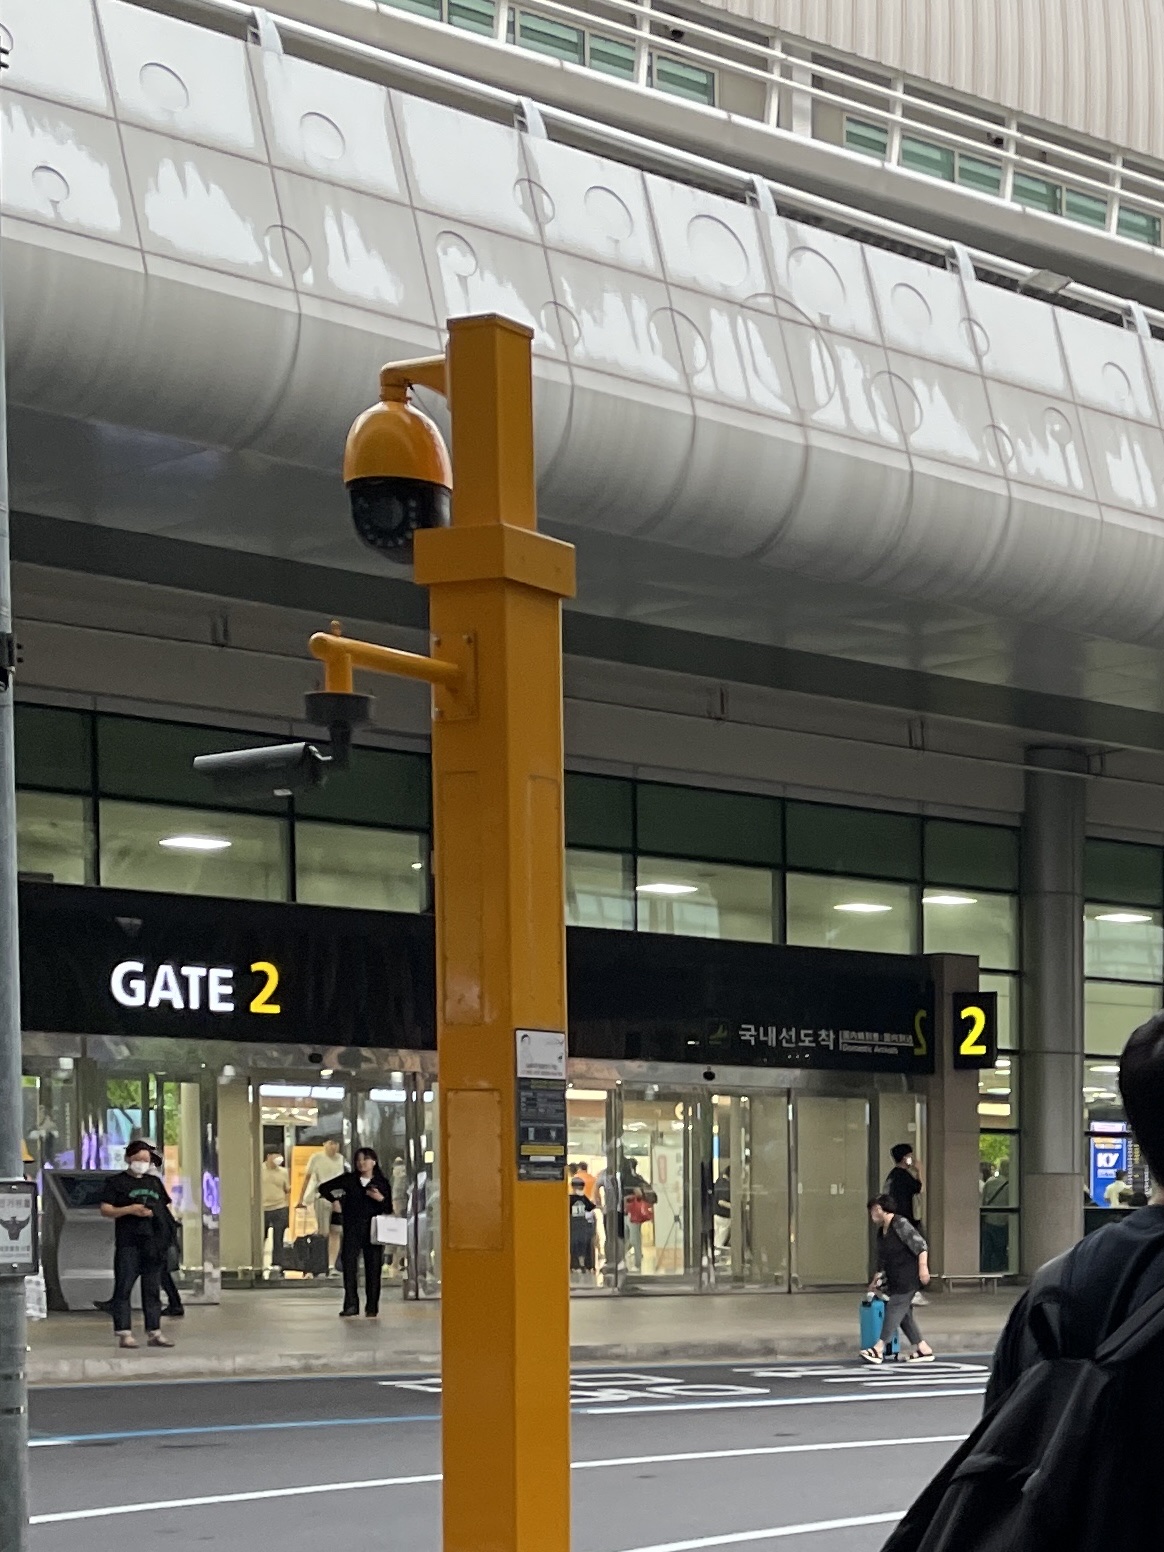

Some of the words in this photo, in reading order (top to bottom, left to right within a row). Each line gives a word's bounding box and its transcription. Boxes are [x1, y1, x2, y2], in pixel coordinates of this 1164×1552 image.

[111, 961, 234, 1012] GATE
[250, 961, 281, 1014] 2
[738, 1024, 836, 1051] 국내선도착
[960, 1006, 987, 1055] 2
